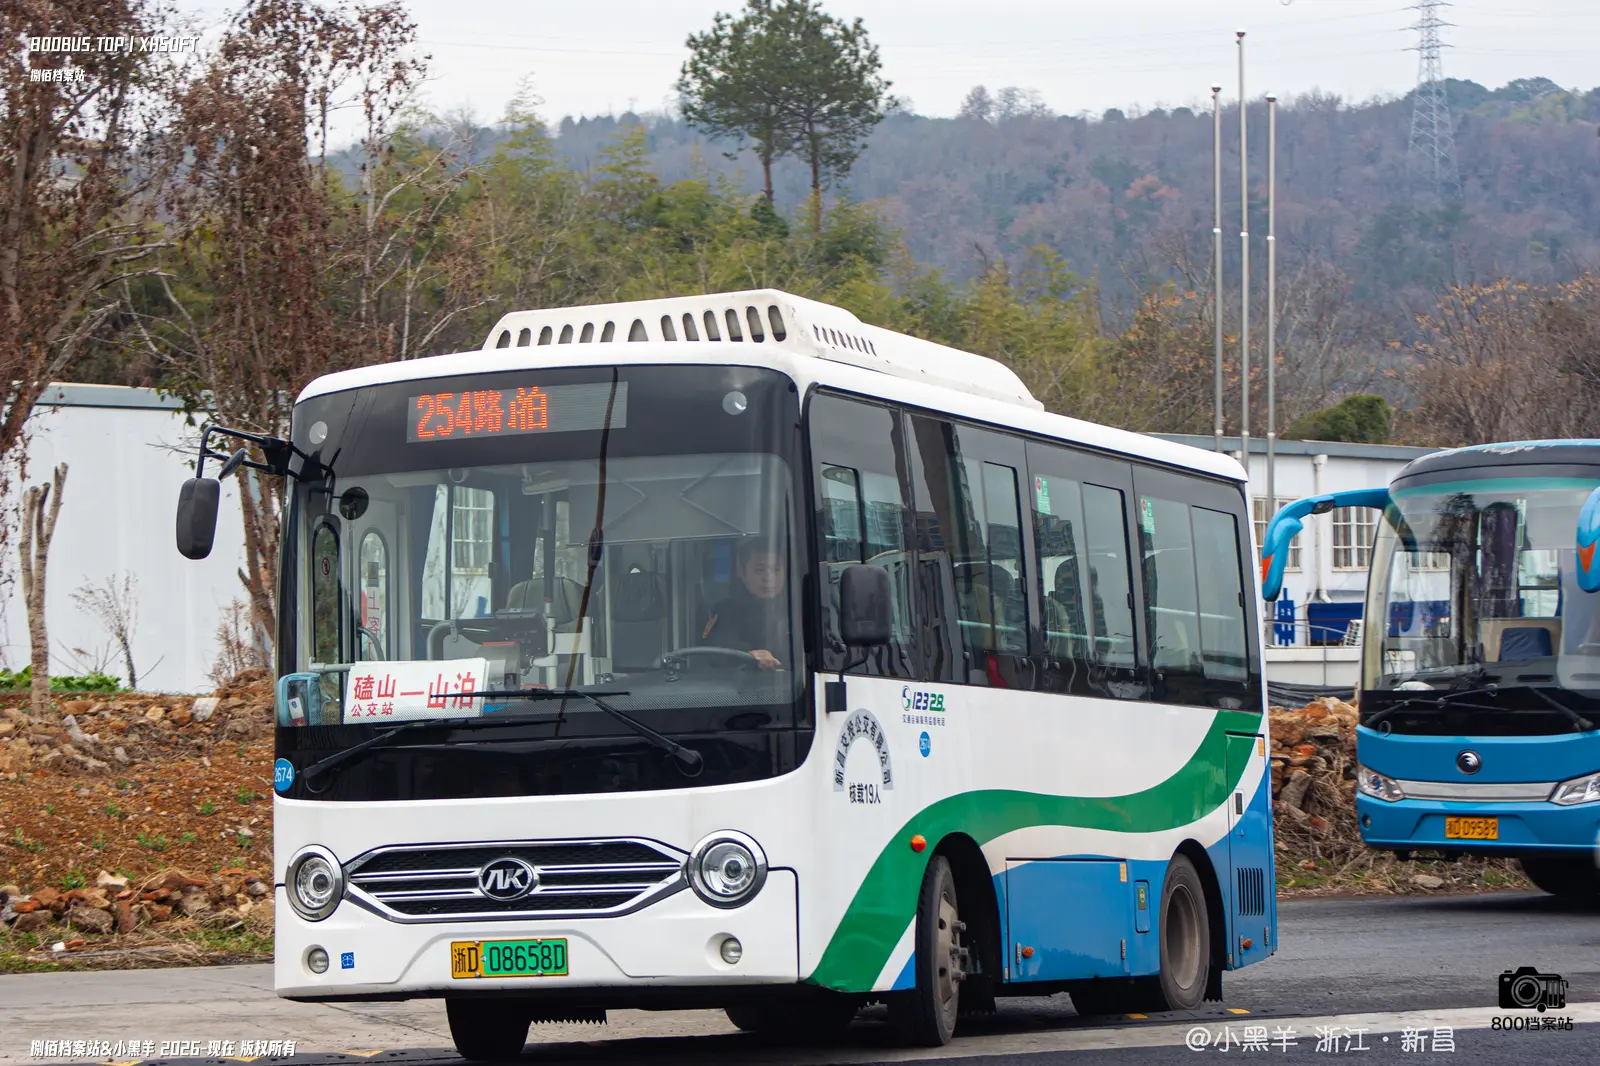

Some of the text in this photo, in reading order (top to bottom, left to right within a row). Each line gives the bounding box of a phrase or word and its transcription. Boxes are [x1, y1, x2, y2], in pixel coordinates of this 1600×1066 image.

[351, 702, 394, 717] 公交站
[912, 691, 946, 712] 12328
[489, 944, 565, 972] 08658D
